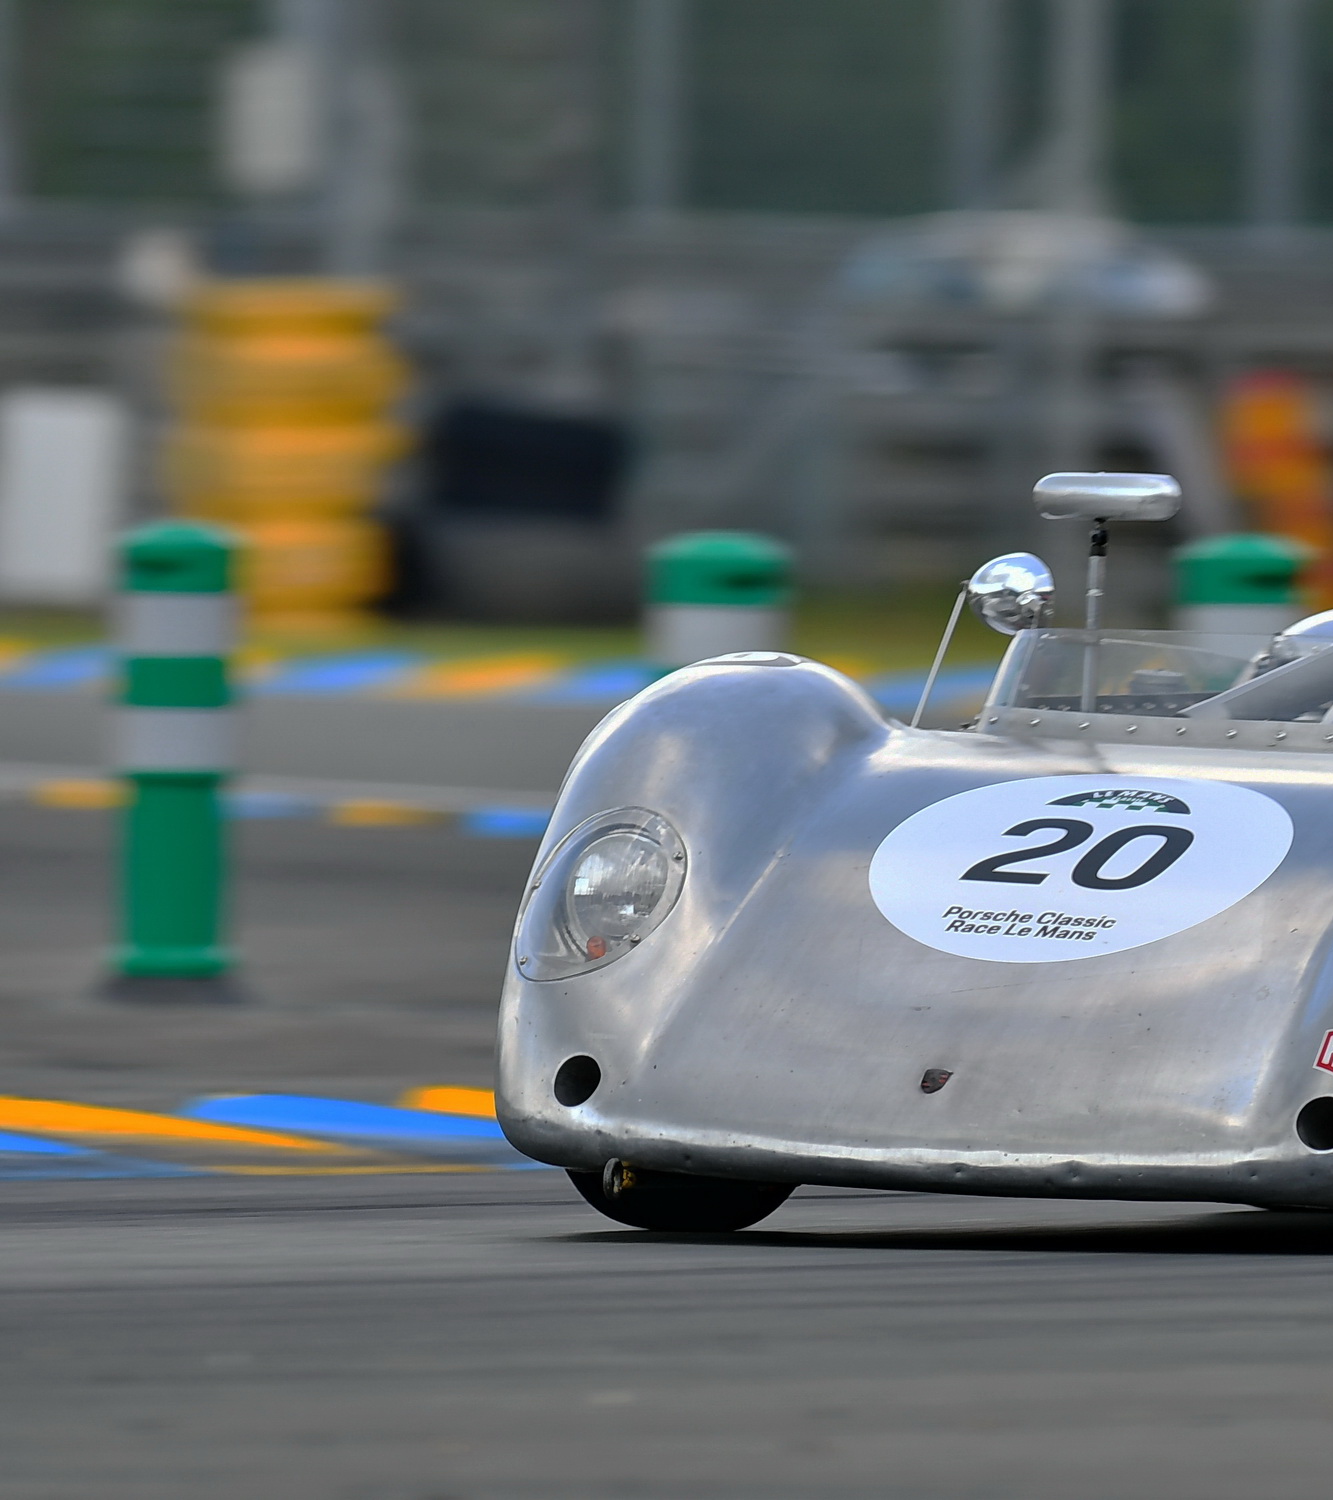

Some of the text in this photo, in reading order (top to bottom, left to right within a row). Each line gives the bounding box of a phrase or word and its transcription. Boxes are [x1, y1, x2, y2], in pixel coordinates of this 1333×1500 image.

[1092, 790, 1115, 799] LE
[1119, 789, 1176, 804] MANS
[958, 818, 1195, 890] 20
[942, 905, 1117, 929] Porsche Classic
[945, 919, 1098, 941] Race Le Mans
